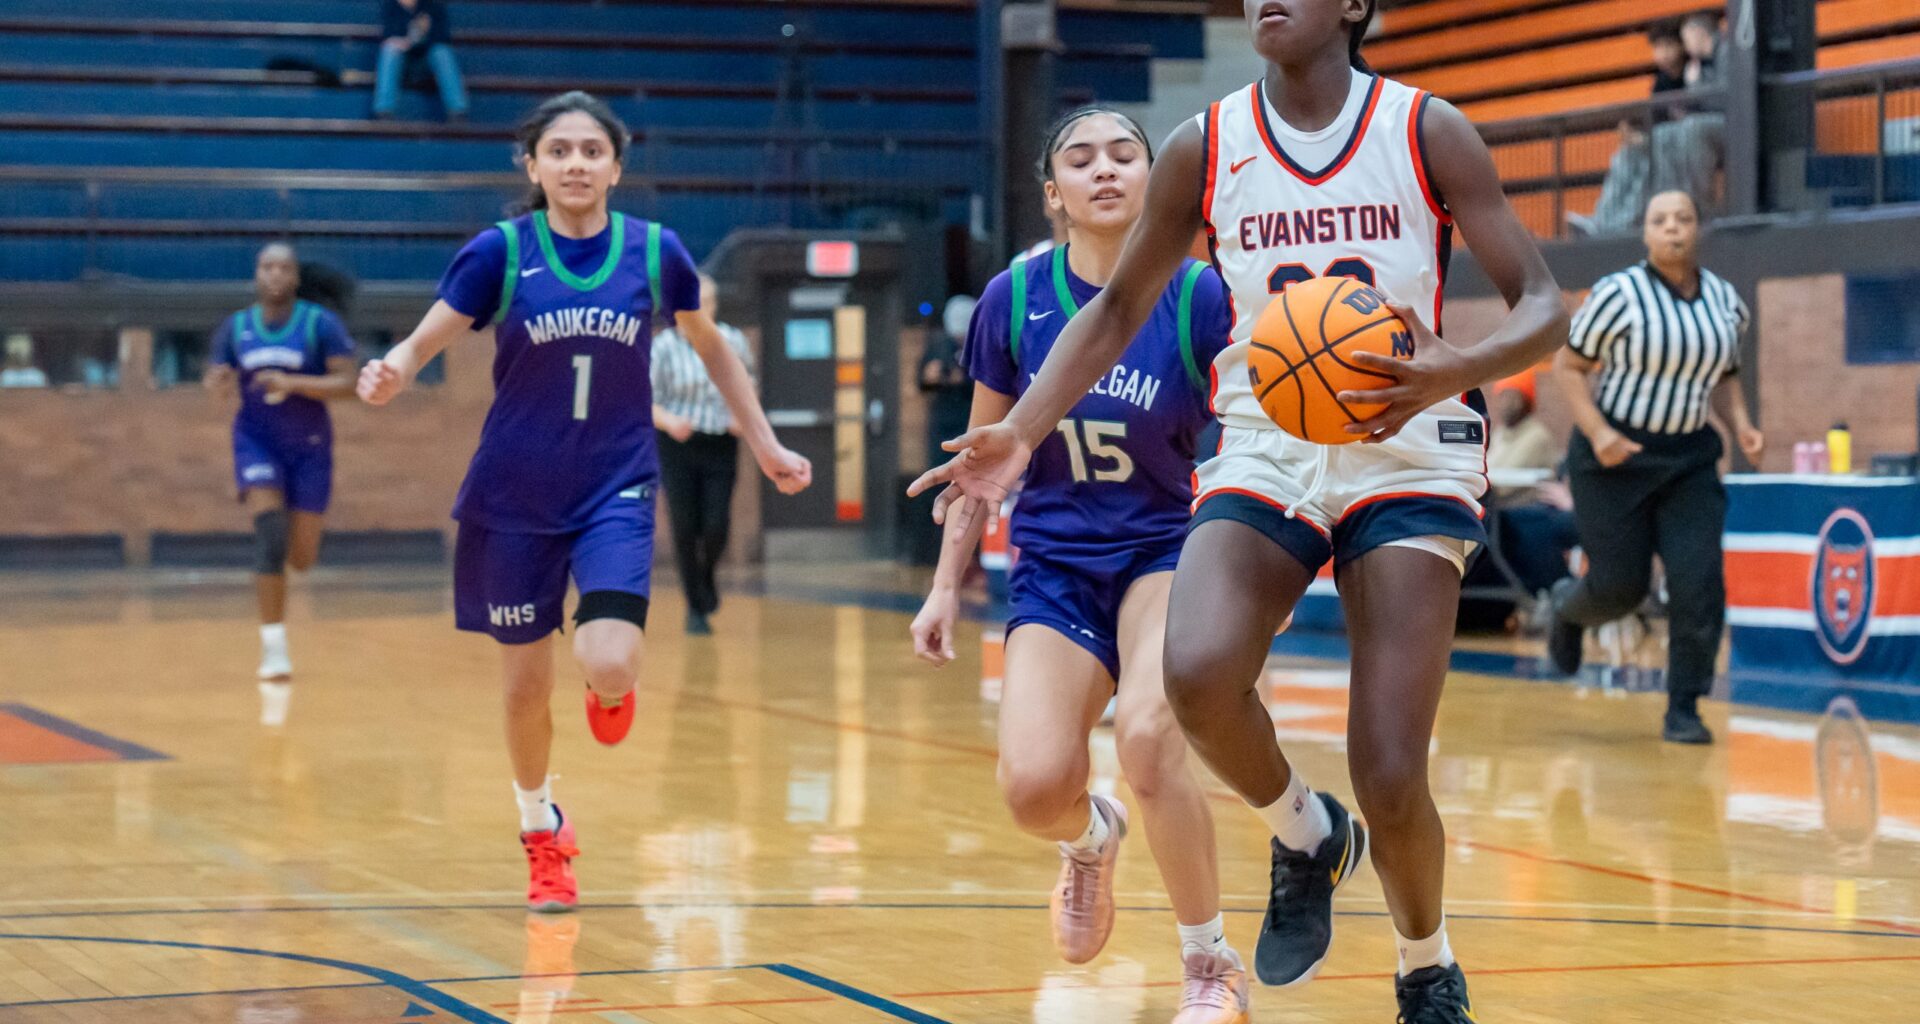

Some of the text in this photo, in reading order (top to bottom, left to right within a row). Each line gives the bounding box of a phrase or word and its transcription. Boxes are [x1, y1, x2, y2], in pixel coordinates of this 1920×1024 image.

[1239, 204, 1401, 252] EVANSTON
[524, 306, 641, 347] WAUKEGAN
[572, 355, 592, 420] 1
[1056, 418, 1134, 483] 15
[488, 602, 536, 626] WHS
